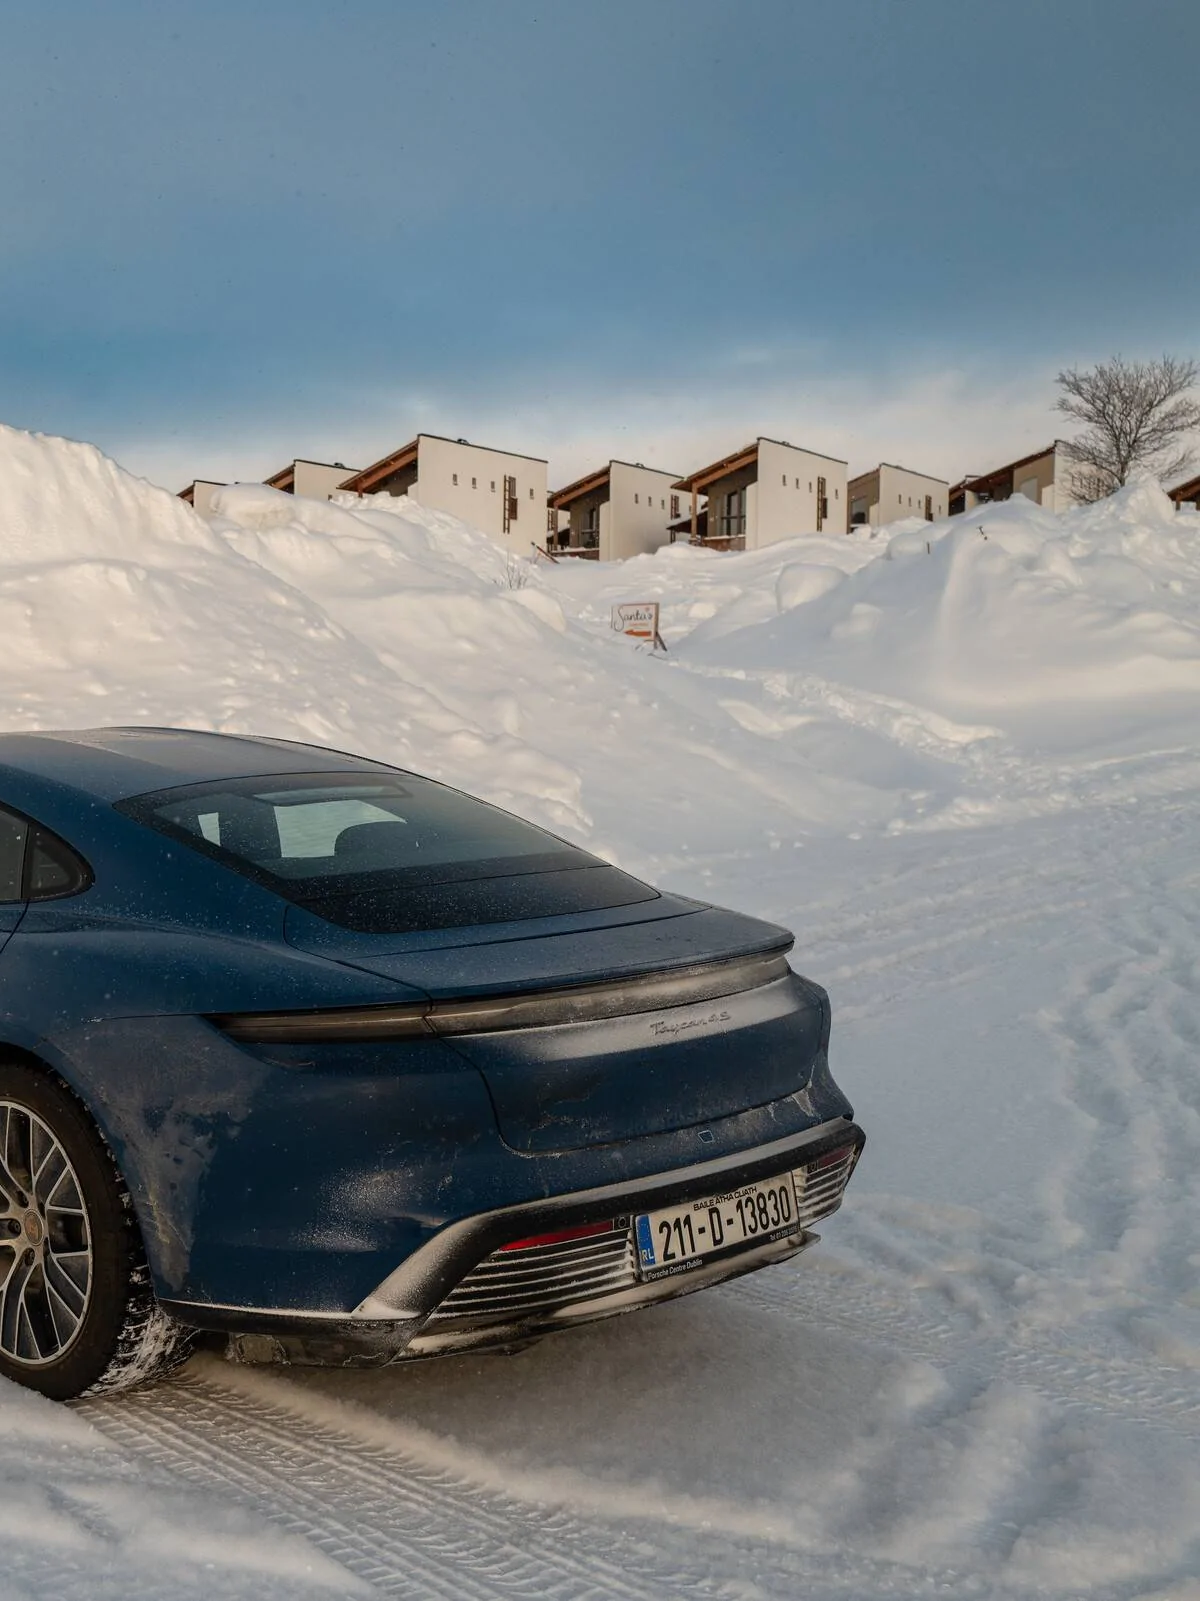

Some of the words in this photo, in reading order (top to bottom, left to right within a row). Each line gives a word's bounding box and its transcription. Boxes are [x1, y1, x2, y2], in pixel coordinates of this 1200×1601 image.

[693, 1200, 715, 1211] BAILE
[658, 1185, 792, 1262] 211-D-13830
[648, 1268, 669, 1281] Porsche
[669, 1264, 686, 1275] Centre
[686, 1259, 703, 1271] Dublin
